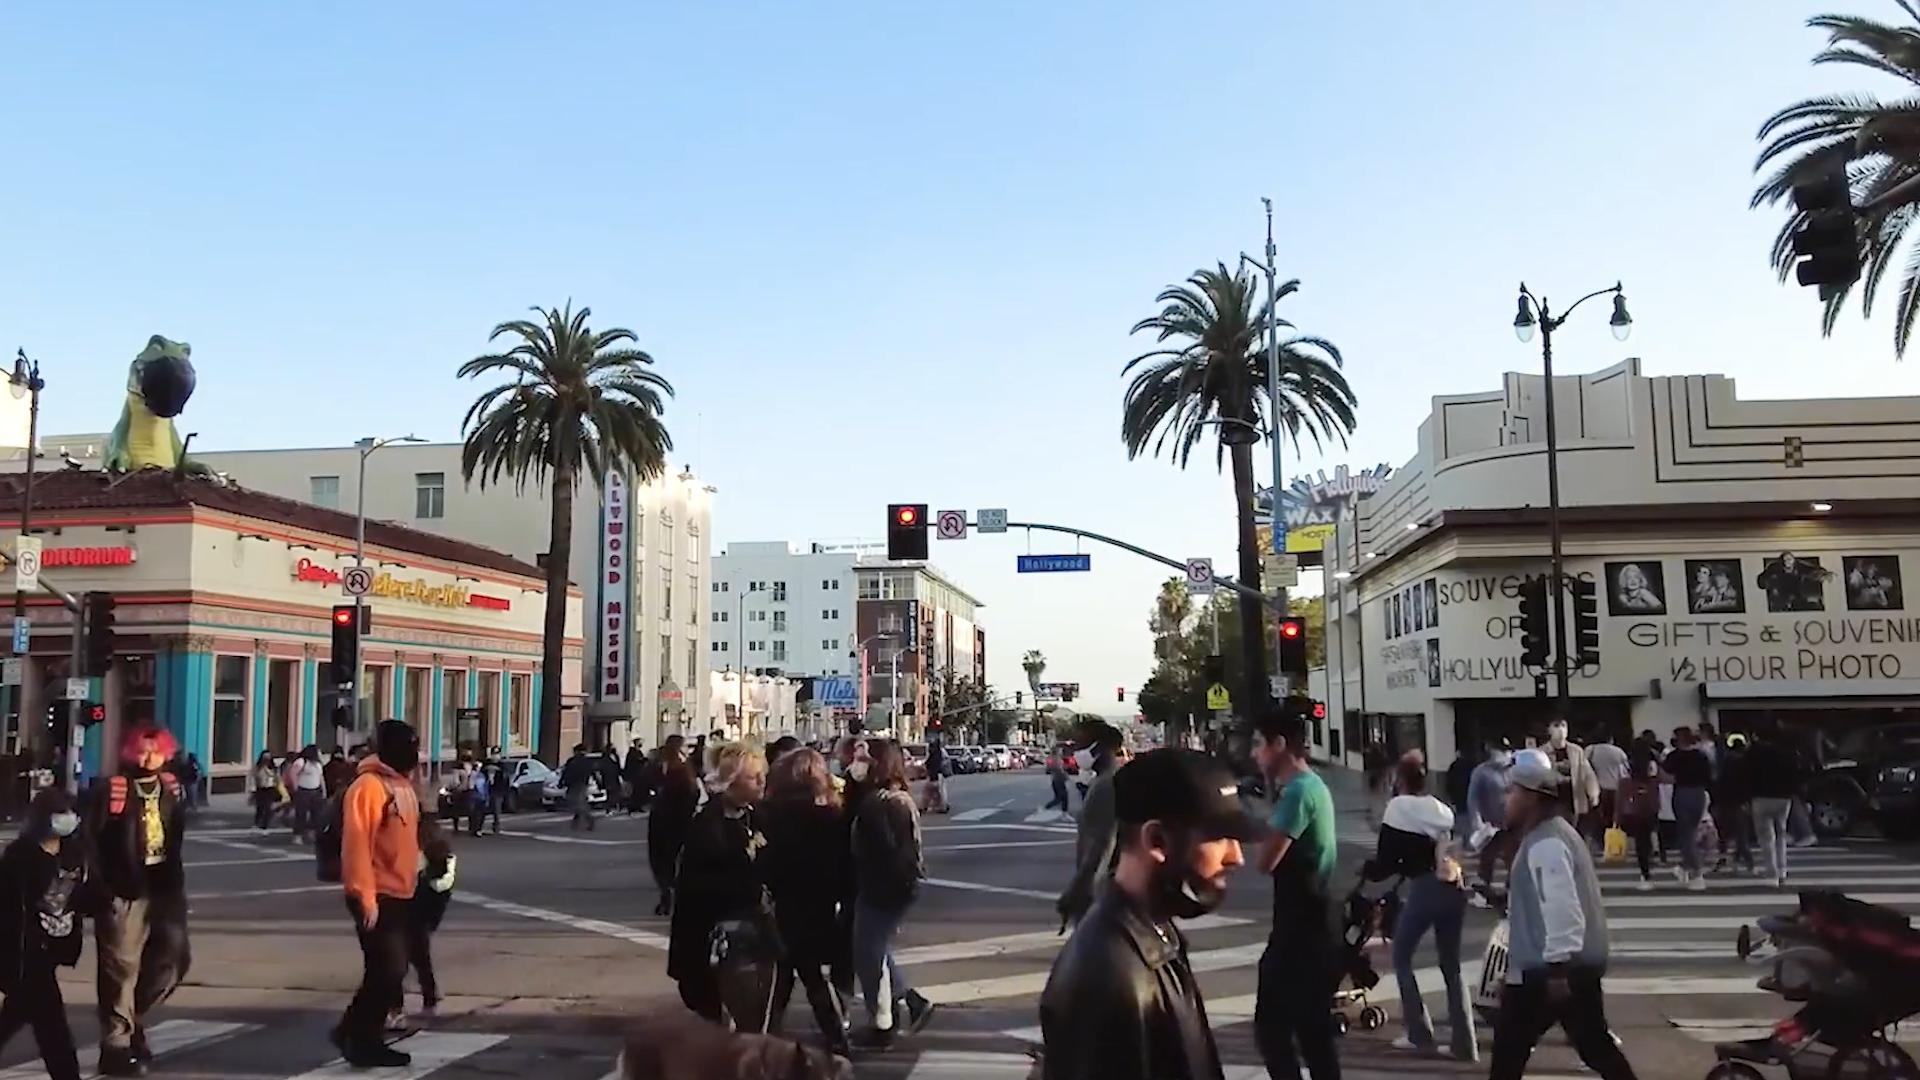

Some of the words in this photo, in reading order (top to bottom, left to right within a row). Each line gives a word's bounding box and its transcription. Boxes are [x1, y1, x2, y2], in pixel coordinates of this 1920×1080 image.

[607, 473, 623, 584] LLYWOOD
[1285, 507, 1332, 527] WAX
[1025, 557, 1083, 570] Hollywood
[1627, 621, 1749, 647] GIFTS
[1760, 625, 1781, 643] &
[606, 601, 622, 696] MUSEUM
[1703, 656, 1786, 681] HOUR
